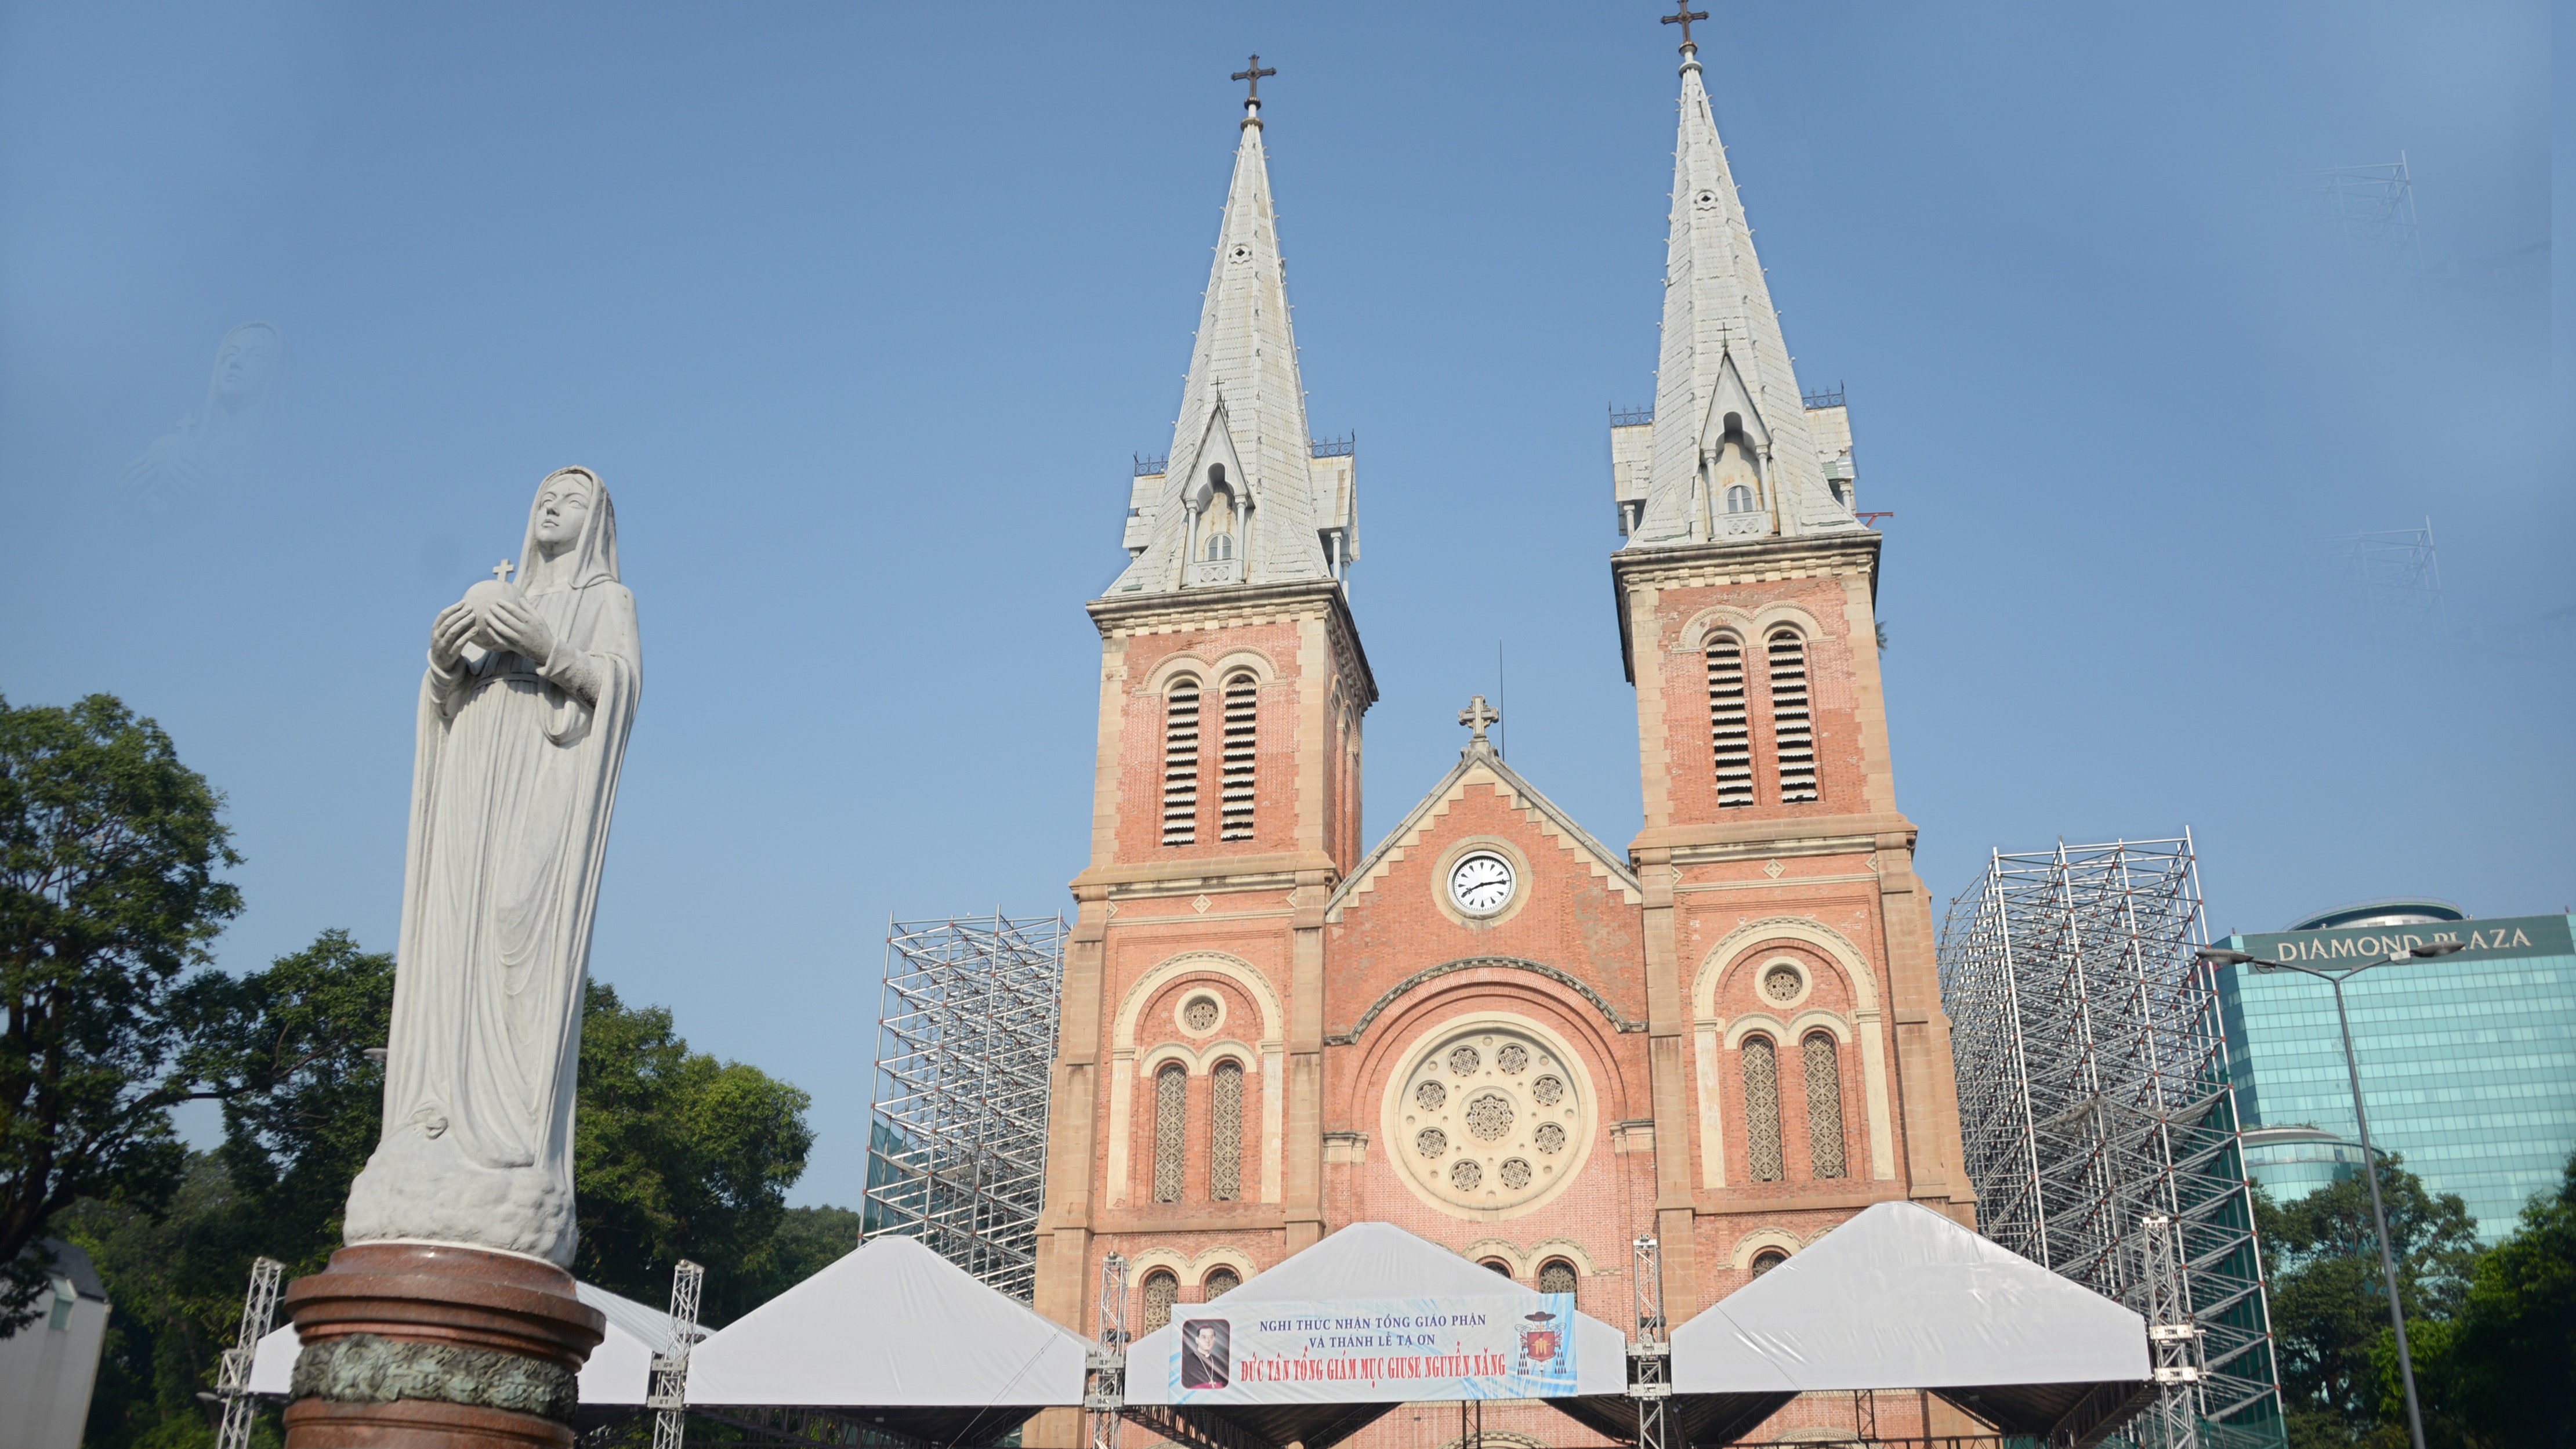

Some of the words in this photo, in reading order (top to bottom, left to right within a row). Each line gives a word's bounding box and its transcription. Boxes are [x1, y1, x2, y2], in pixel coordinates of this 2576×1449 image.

[2277, 934, 2423, 962] DIAMOND
[1260, 1320, 1292, 1332] NGHI
[1296, 1317, 1331, 1330] THỨC
[1335, 1316, 1371, 1331] NHẬN
[1415, 1314, 1447, 1327] GIÁO
[1451, 1313, 1486, 1328] PHẬN
[1309, 1335, 1325, 1348] VÀ
[1329, 1334, 1374, 1347] THÁNH
[1397, 1334, 1413, 1347] TẠ
[1417, 1334, 1435, 1345] ƠN
[1241, 1352, 1264, 1382] ĐỨC
[1267, 1352, 1290, 1381] TÂN
[1294, 1345, 1324, 1381] TỔNG
[1327, 1349, 1357, 1381] GIÁM
[1360, 1357, 1385, 1389] MỤC
[1387, 1355, 1421, 1379] GIUSE
[1474, 1347, 1506, 1376] NĂNG
